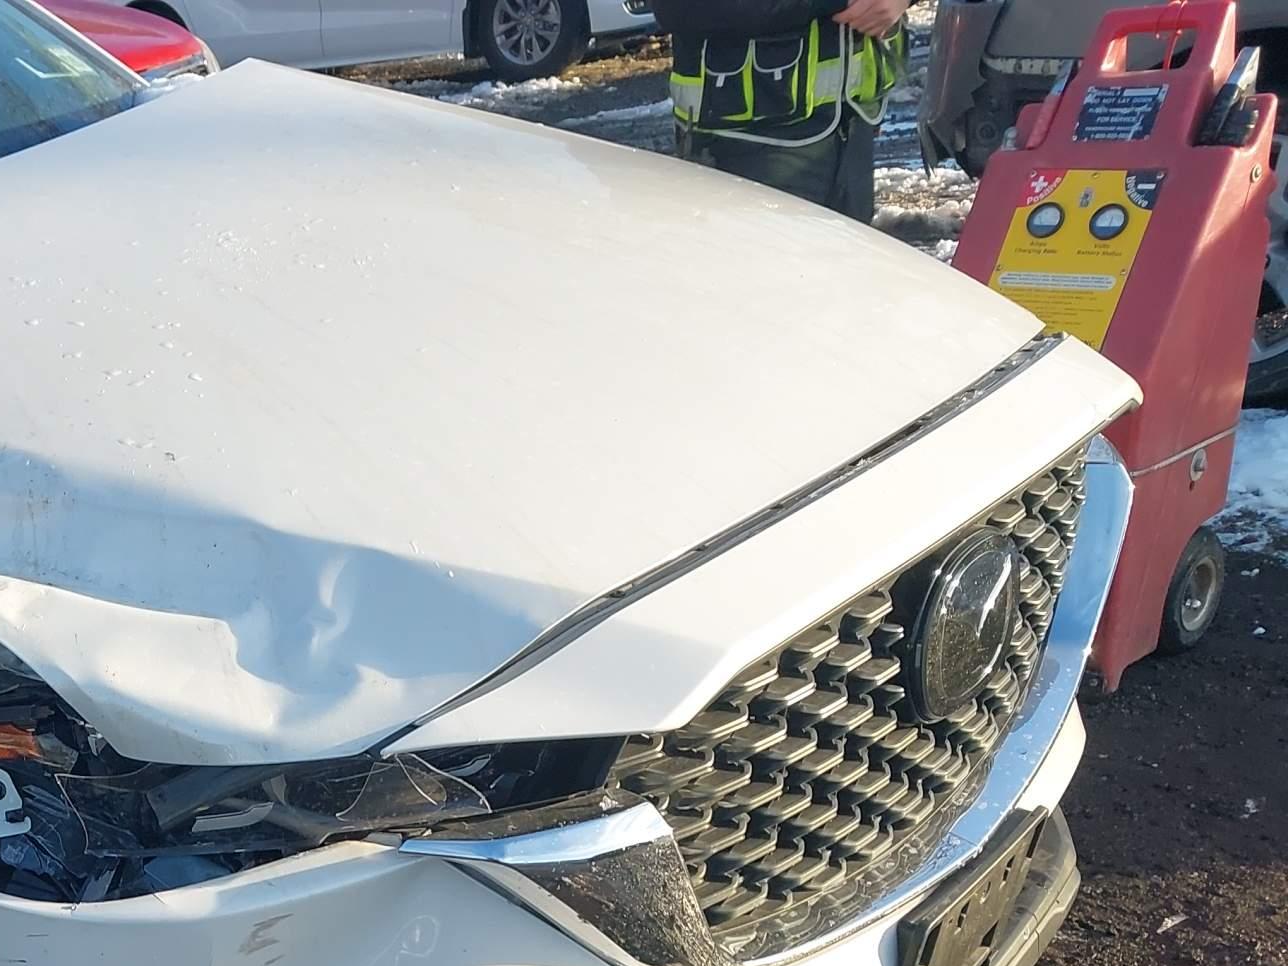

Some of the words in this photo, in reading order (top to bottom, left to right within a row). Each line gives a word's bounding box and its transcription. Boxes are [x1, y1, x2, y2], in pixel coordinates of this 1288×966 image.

[1026, 176, 1062, 205] Positive
[1126, 175, 1149, 208] Negative
[1014, 247, 1043, 255] Charging
[1076, 249, 1100, 257] Battery
